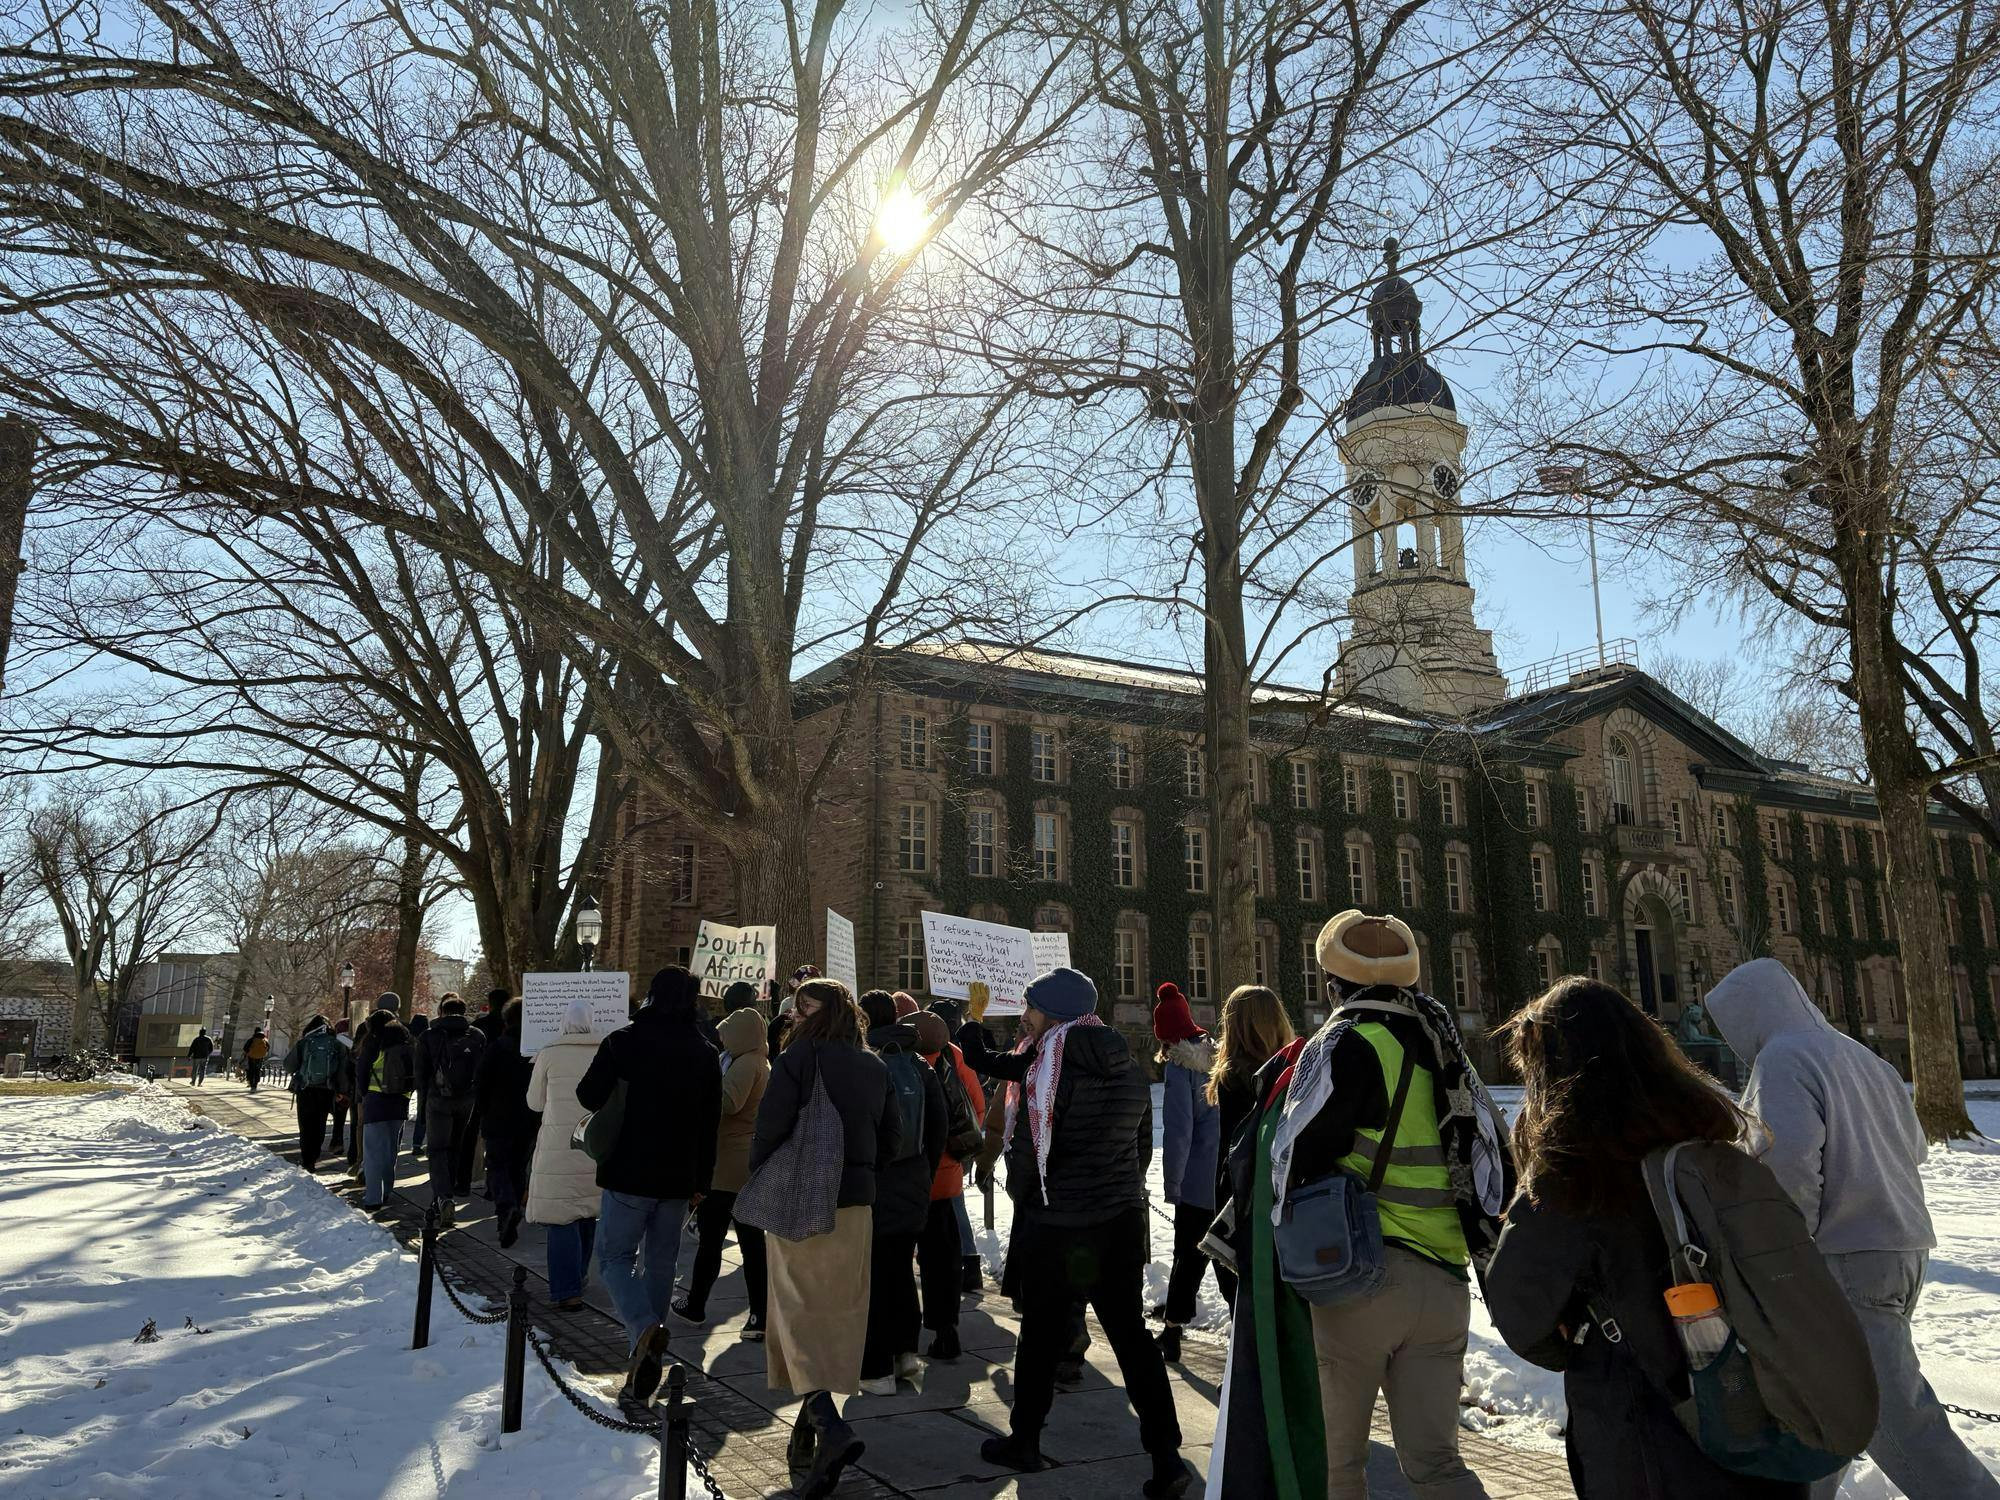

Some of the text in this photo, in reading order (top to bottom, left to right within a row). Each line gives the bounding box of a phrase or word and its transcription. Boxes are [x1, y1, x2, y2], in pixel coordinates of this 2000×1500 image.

[697, 925, 765, 956] South
[929, 920, 1022, 945] I refuse to support
[940, 938, 983, 956] university
[986, 941, 1010, 956] that
[704, 955, 766, 980] Africa
[962, 953, 1000, 966] genocide
[1005, 959, 1025, 969] and
[986, 965, 1006, 978] very
[1010, 971, 1032, 981] own
[989, 973, 1025, 989] standing
[990, 983, 1015, 998] ights
